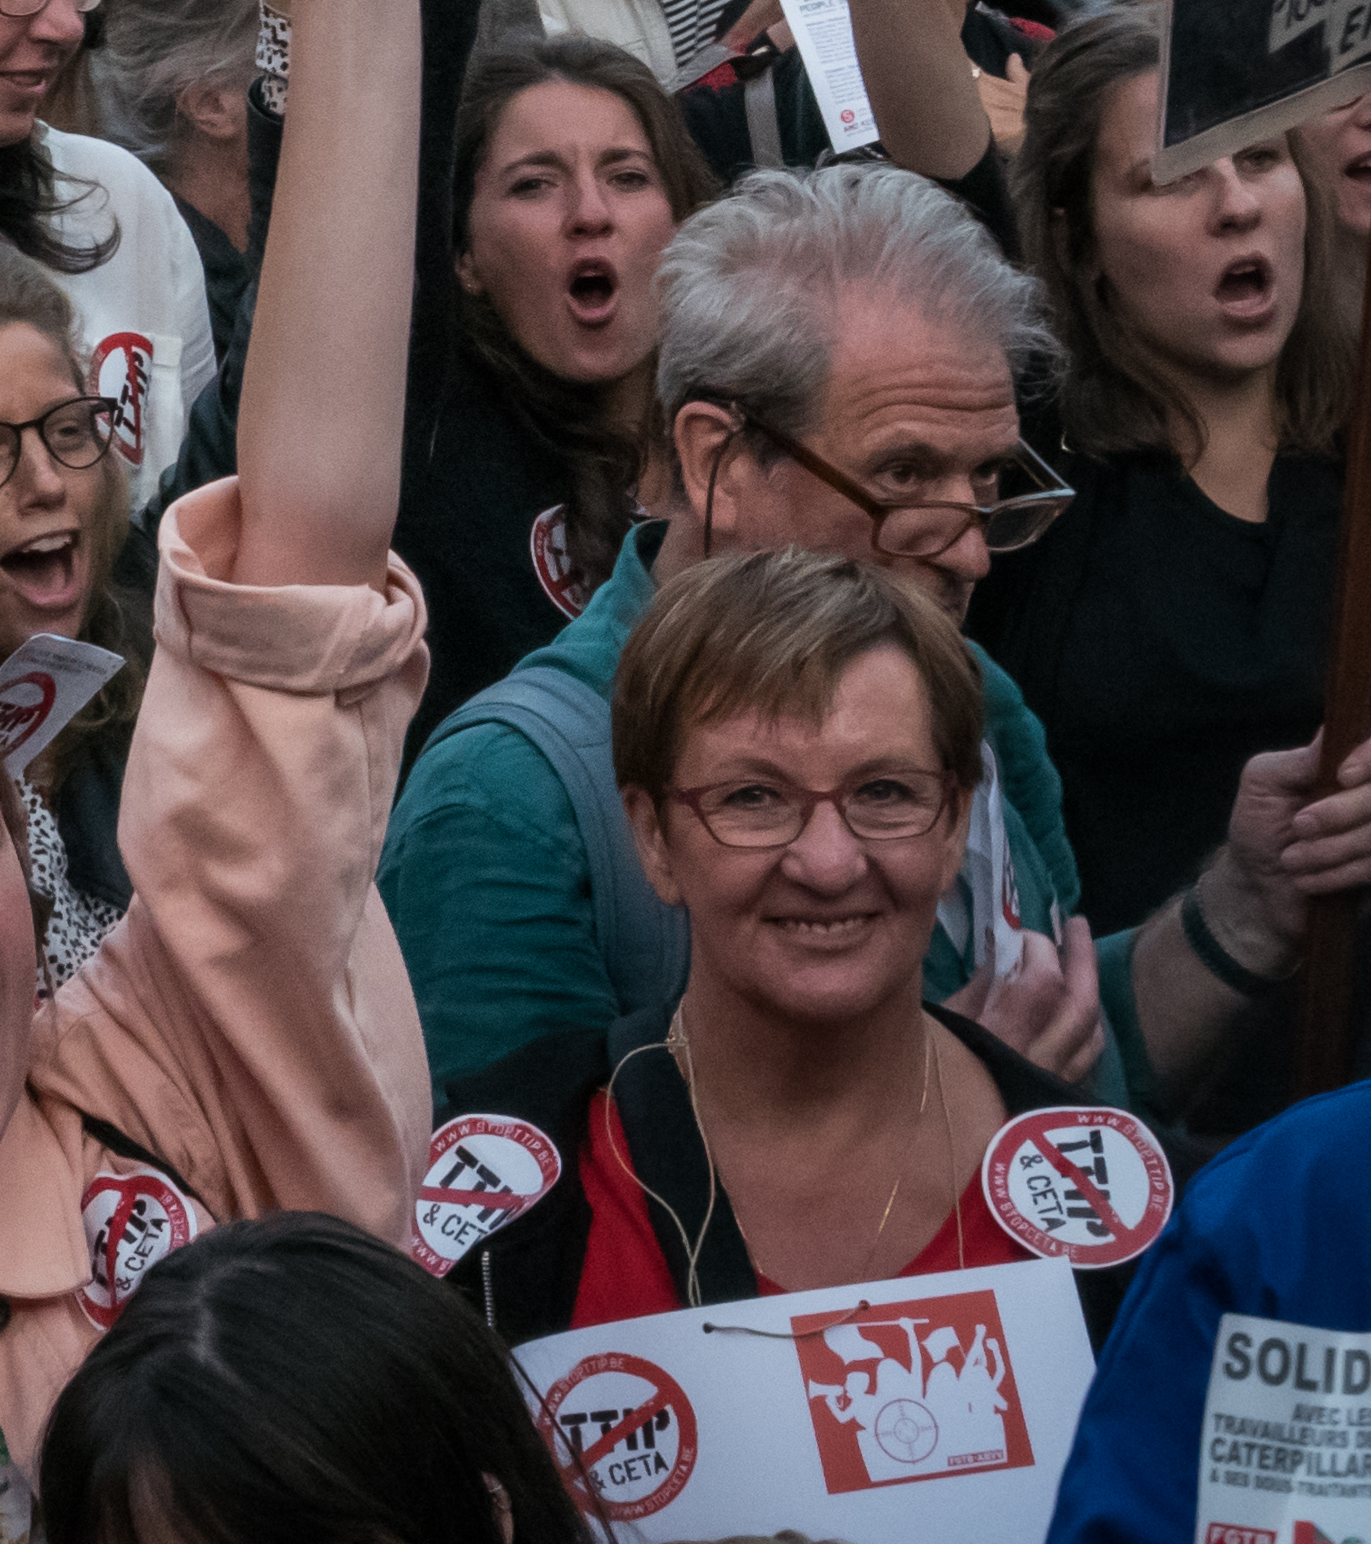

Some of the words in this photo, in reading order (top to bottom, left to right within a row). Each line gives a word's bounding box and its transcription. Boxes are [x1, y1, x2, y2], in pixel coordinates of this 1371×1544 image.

[1020, 1154, 1044, 1171] &
[1056, 1129, 1111, 1238] TTIP
[423, 1203, 441, 1227] &
[440, 1213, 489, 1246] CET
[1026, 1174, 1067, 1234] CETA
[125, 1218, 169, 1272] CETA
[116, 1276, 135, 1291] &
[560, 1407, 671, 1454] TTIP
[608, 1450, 670, 1486] CETA
